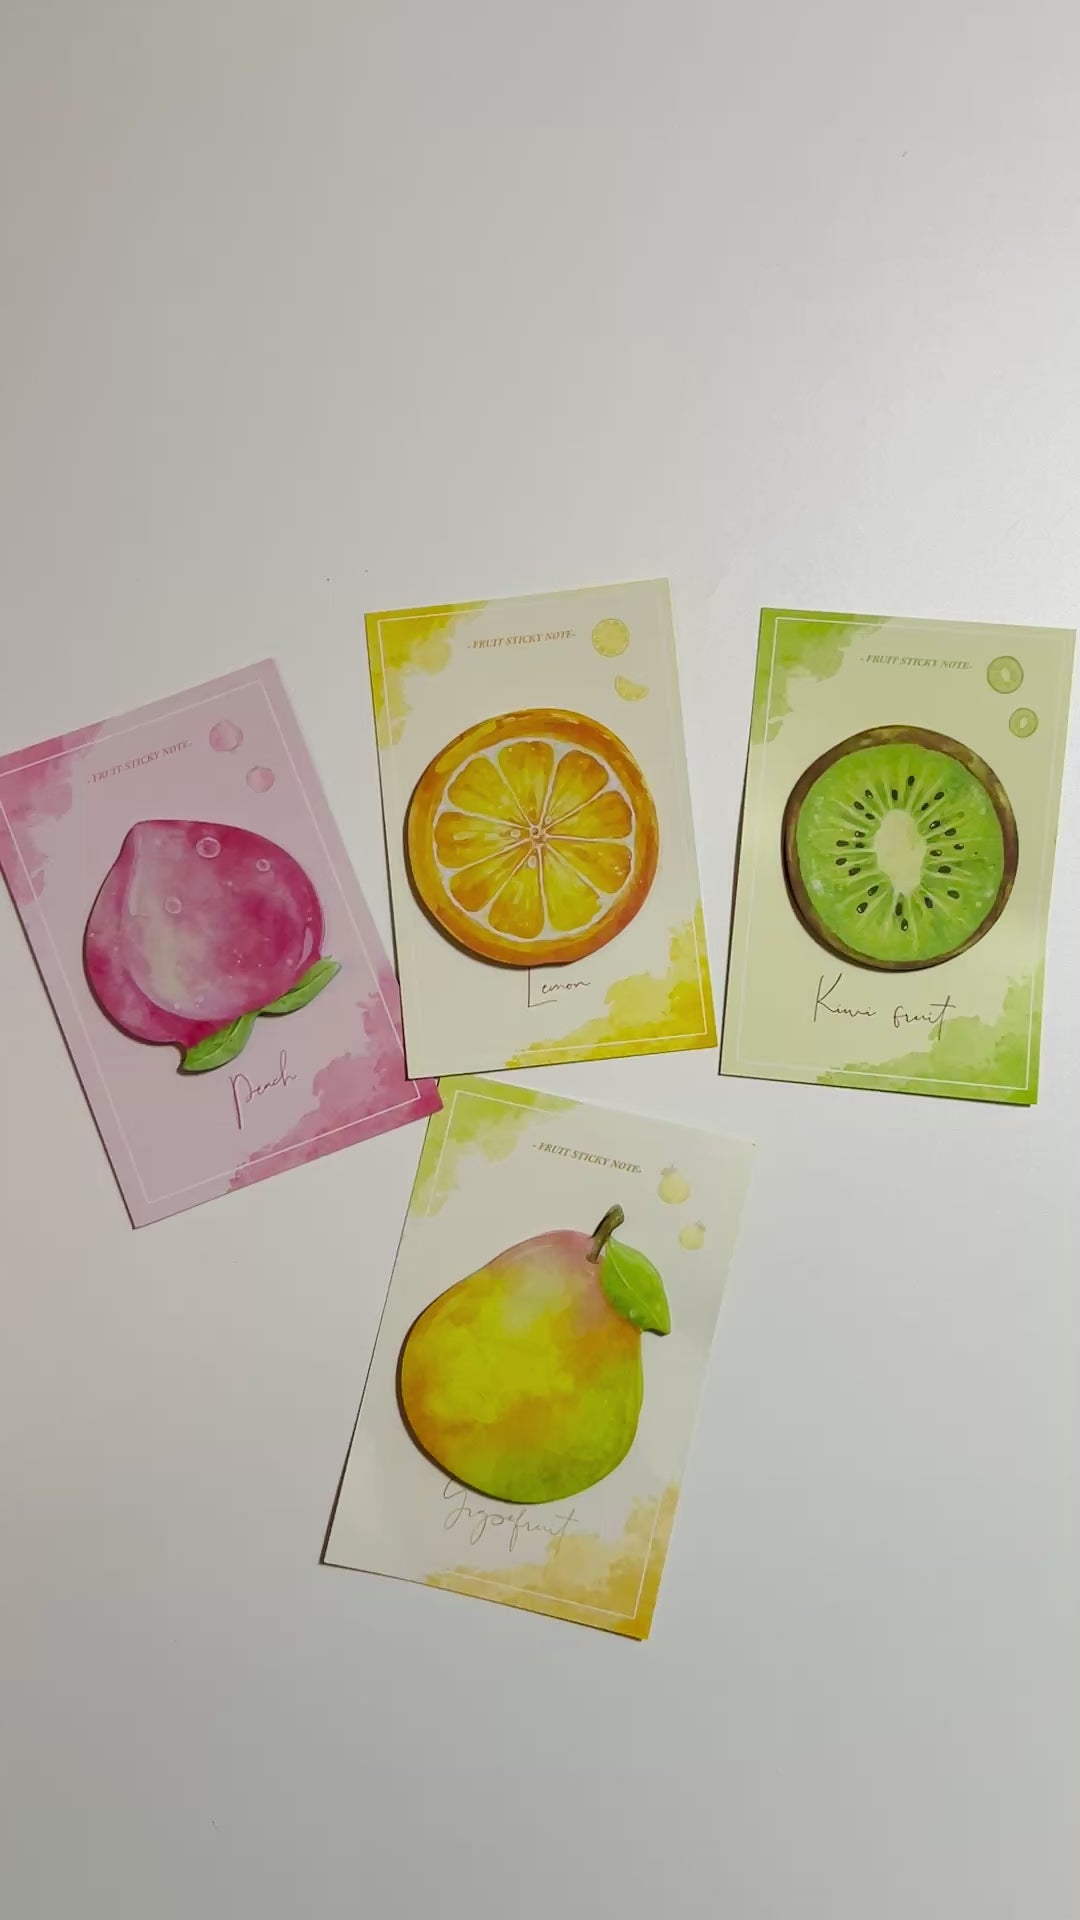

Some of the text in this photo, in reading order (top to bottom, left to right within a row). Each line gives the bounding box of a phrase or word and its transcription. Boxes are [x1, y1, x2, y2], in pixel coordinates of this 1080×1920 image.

[472, 638, 505, 649] FRUIT
[505, 633, 542, 646] STICKY
[865, 654, 900, 664] FRUIT
[900, 656, 938, 667] STICKY
[91, 764, 123, 782] FRUIT
[123, 750, 161, 769] STICKY
[527, 966, 591, 1008] Lemon
[813, 972, 957, 1041] Kiwi fruit
[538, 1141, 572, 1157] FRUIT
[571, 1150, 610, 1166] STICKY
